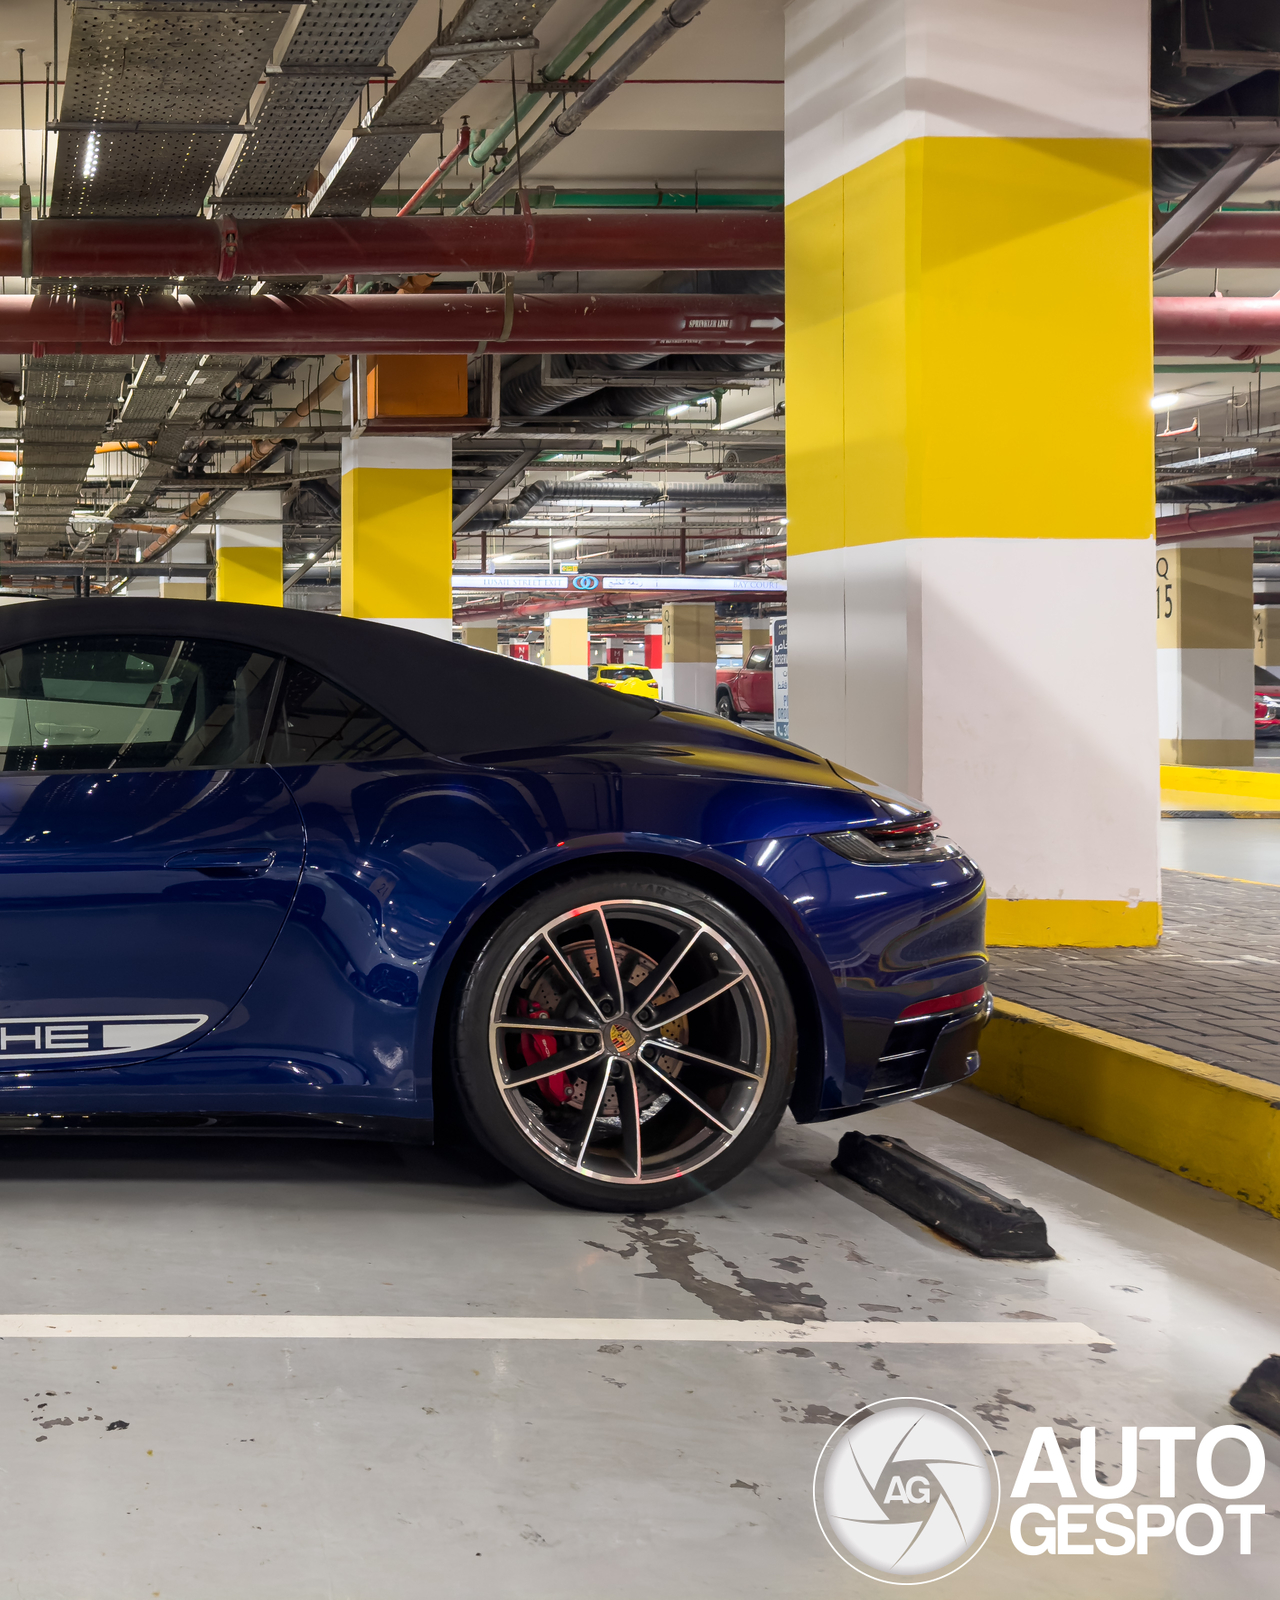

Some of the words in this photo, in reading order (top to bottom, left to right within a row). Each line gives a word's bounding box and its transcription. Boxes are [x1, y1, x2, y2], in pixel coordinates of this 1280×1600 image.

[688, 319, 717, 328] SPRINKLER
[717, 319, 730, 328] LINE
[1156, 557, 1168, 580] Q
[750, 581, 780, 589] COURT
[1156, 584, 1173, 619] 15
[518, 646, 525, 654] N
